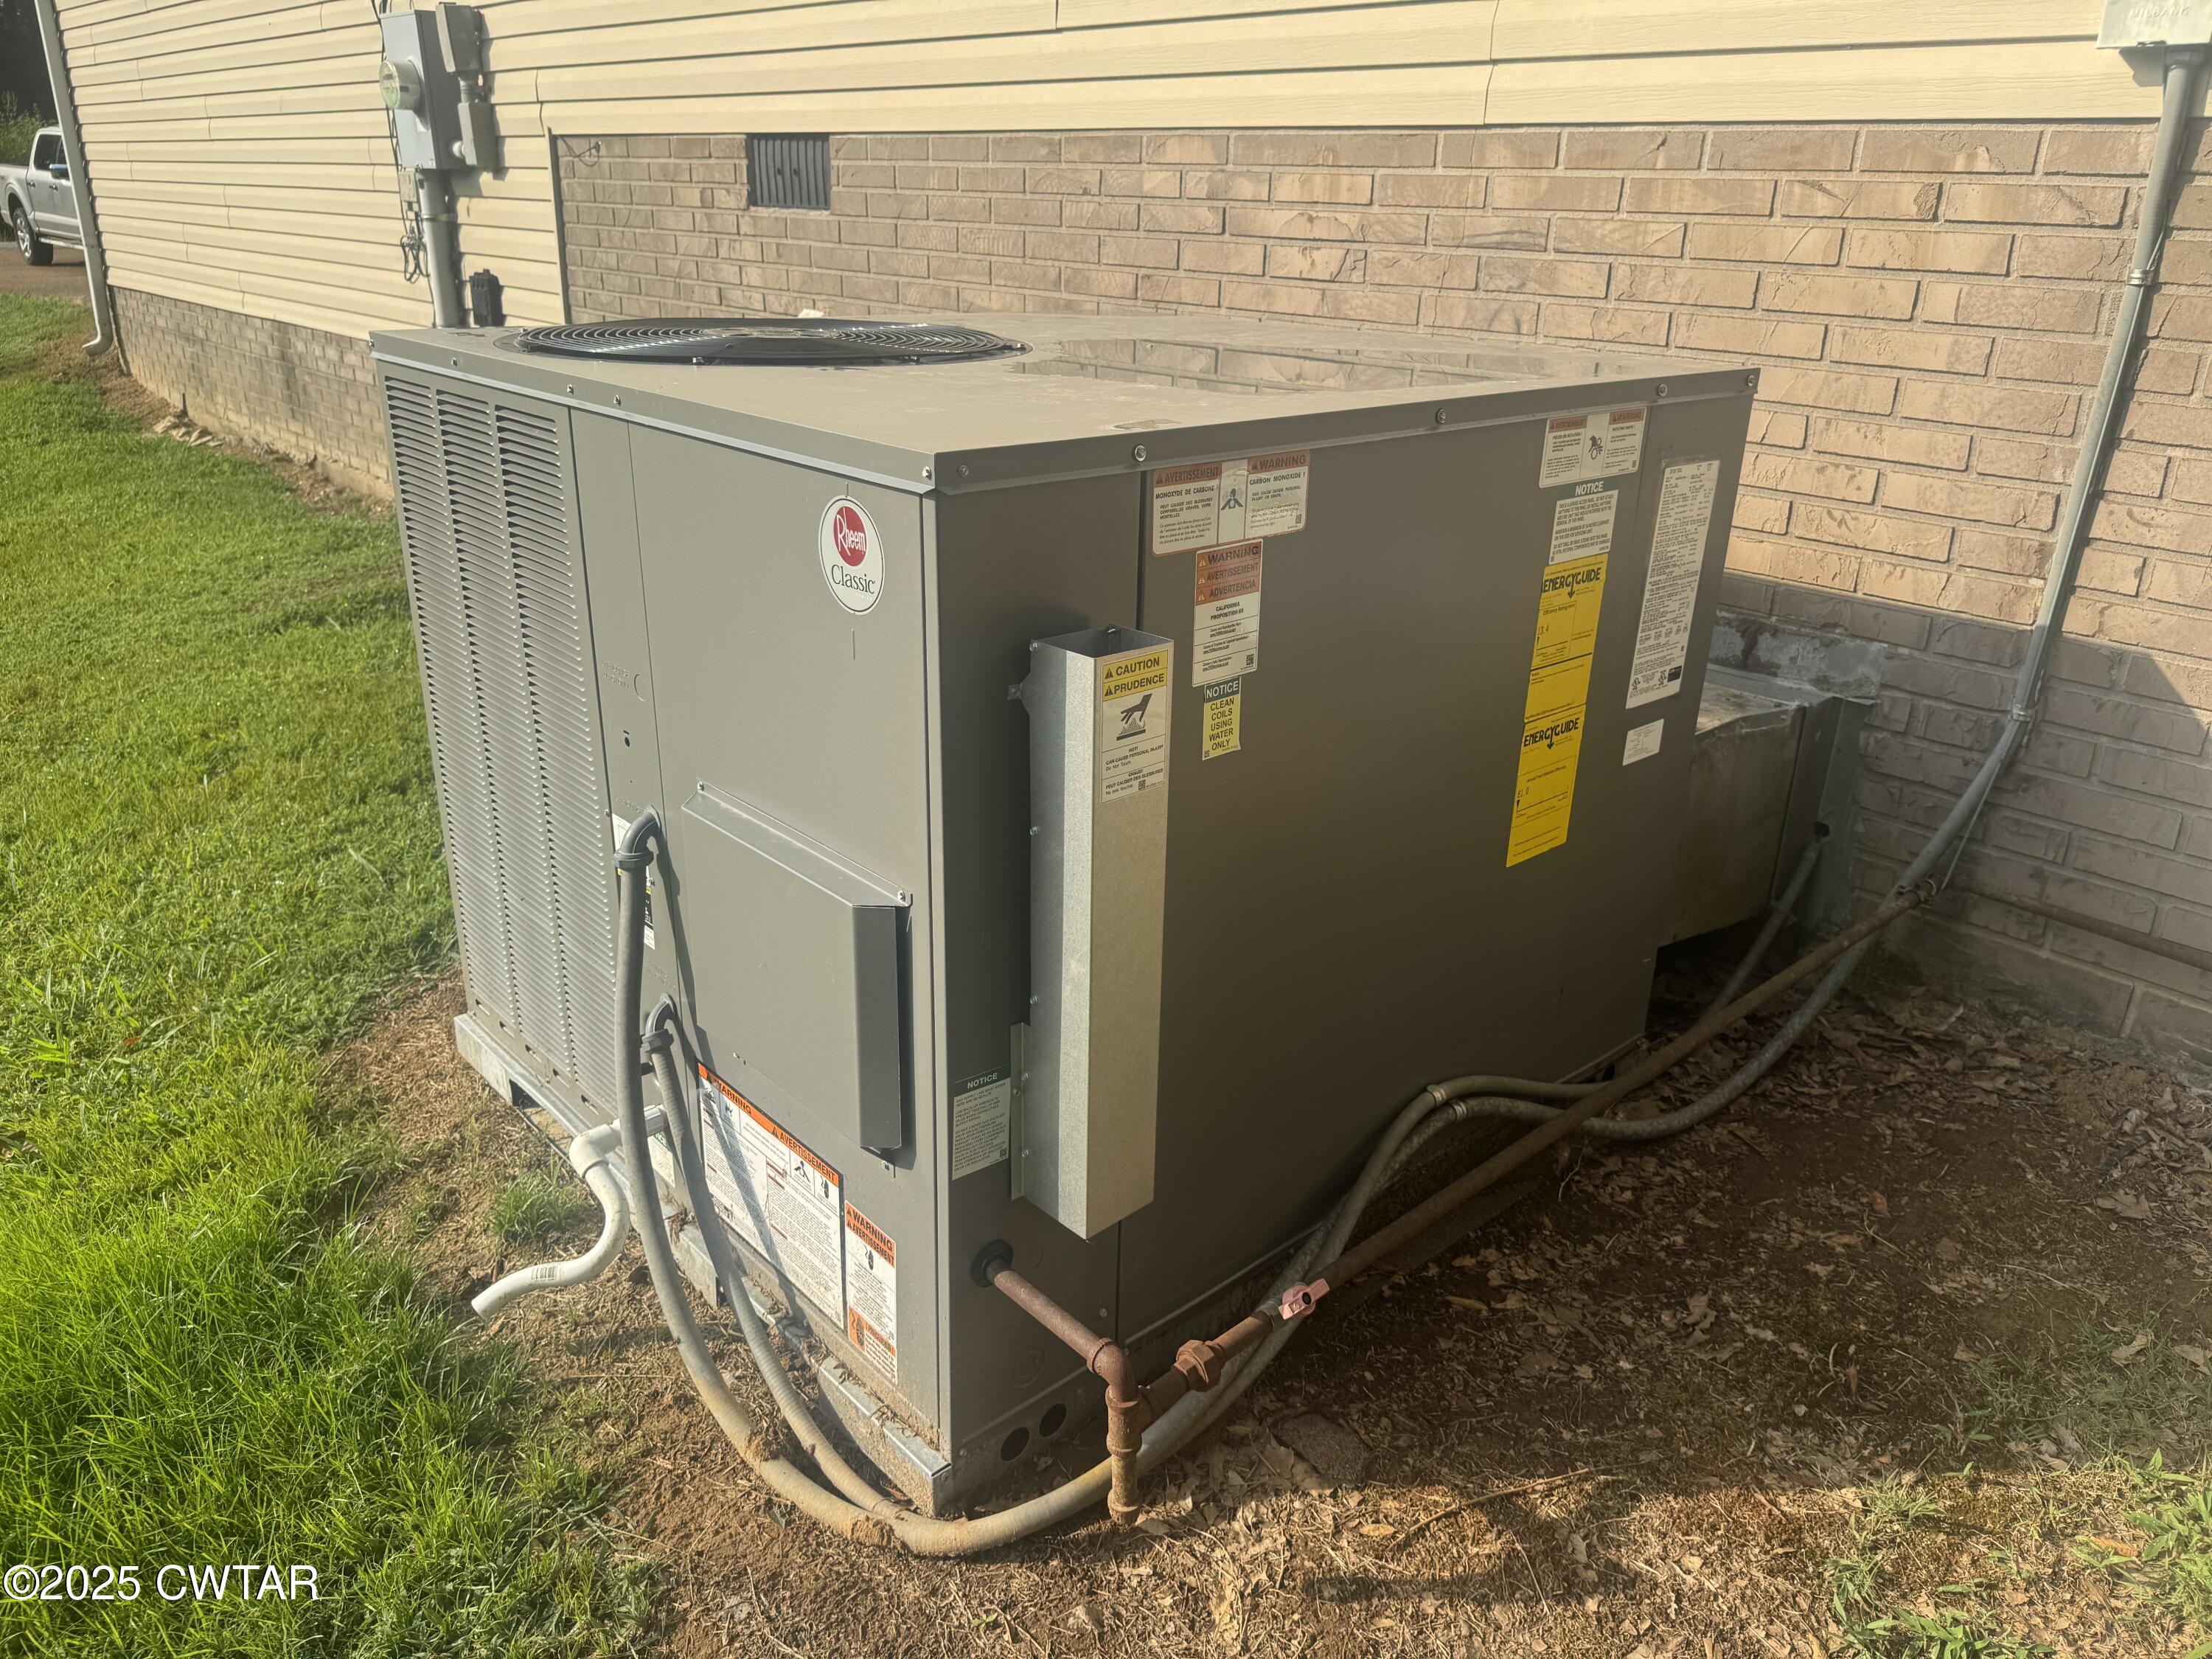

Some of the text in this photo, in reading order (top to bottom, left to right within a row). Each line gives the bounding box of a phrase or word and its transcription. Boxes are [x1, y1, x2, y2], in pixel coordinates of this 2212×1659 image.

[2129, 6, 2190, 19] MILBANK
[1259, 455, 1306, 470] WARNING
[1165, 467, 1219, 484] AVERTISSEMENT
[1249, 476, 1270, 486] CARBON
[1273, 471, 1301, 481] MONOXIDE
[1575, 481, 1604, 495] NOTICE
[837, 507, 866, 556] Rheem
[1208, 546, 1259, 565] WARNING
[832, 565, 875, 594] Classic
[1207, 563, 1259, 582] AVERTISSEMENT
[1543, 567, 1601, 593] ENERGYGUIDE
[1209, 579, 1256, 598] ADVERTENCIA
[1210, 609, 1237, 620] PROPOSITION
[1116, 657, 1160, 676] CAUTION
[1114, 674, 1164, 695] PRUDENCE
[1206, 681, 1239, 699] NOTICE
[1210, 698, 1234, 711] CLEAN
[1211, 709, 1233, 721] COILS
[1211, 718, 1233, 731] USING
[1523, 717, 1579, 747] ENERGYGUIDE
[1209, 728, 1234, 742] WATER
[1211, 739, 1230, 751] ONLY
[967, 1073, 998, 1089] NOTICE
[780, 1133, 835, 1181] AVERTISSEMENT
[853, 1210, 892, 1252] WARNING
[853, 1224, 894, 1265] AVERTISSEMENT
